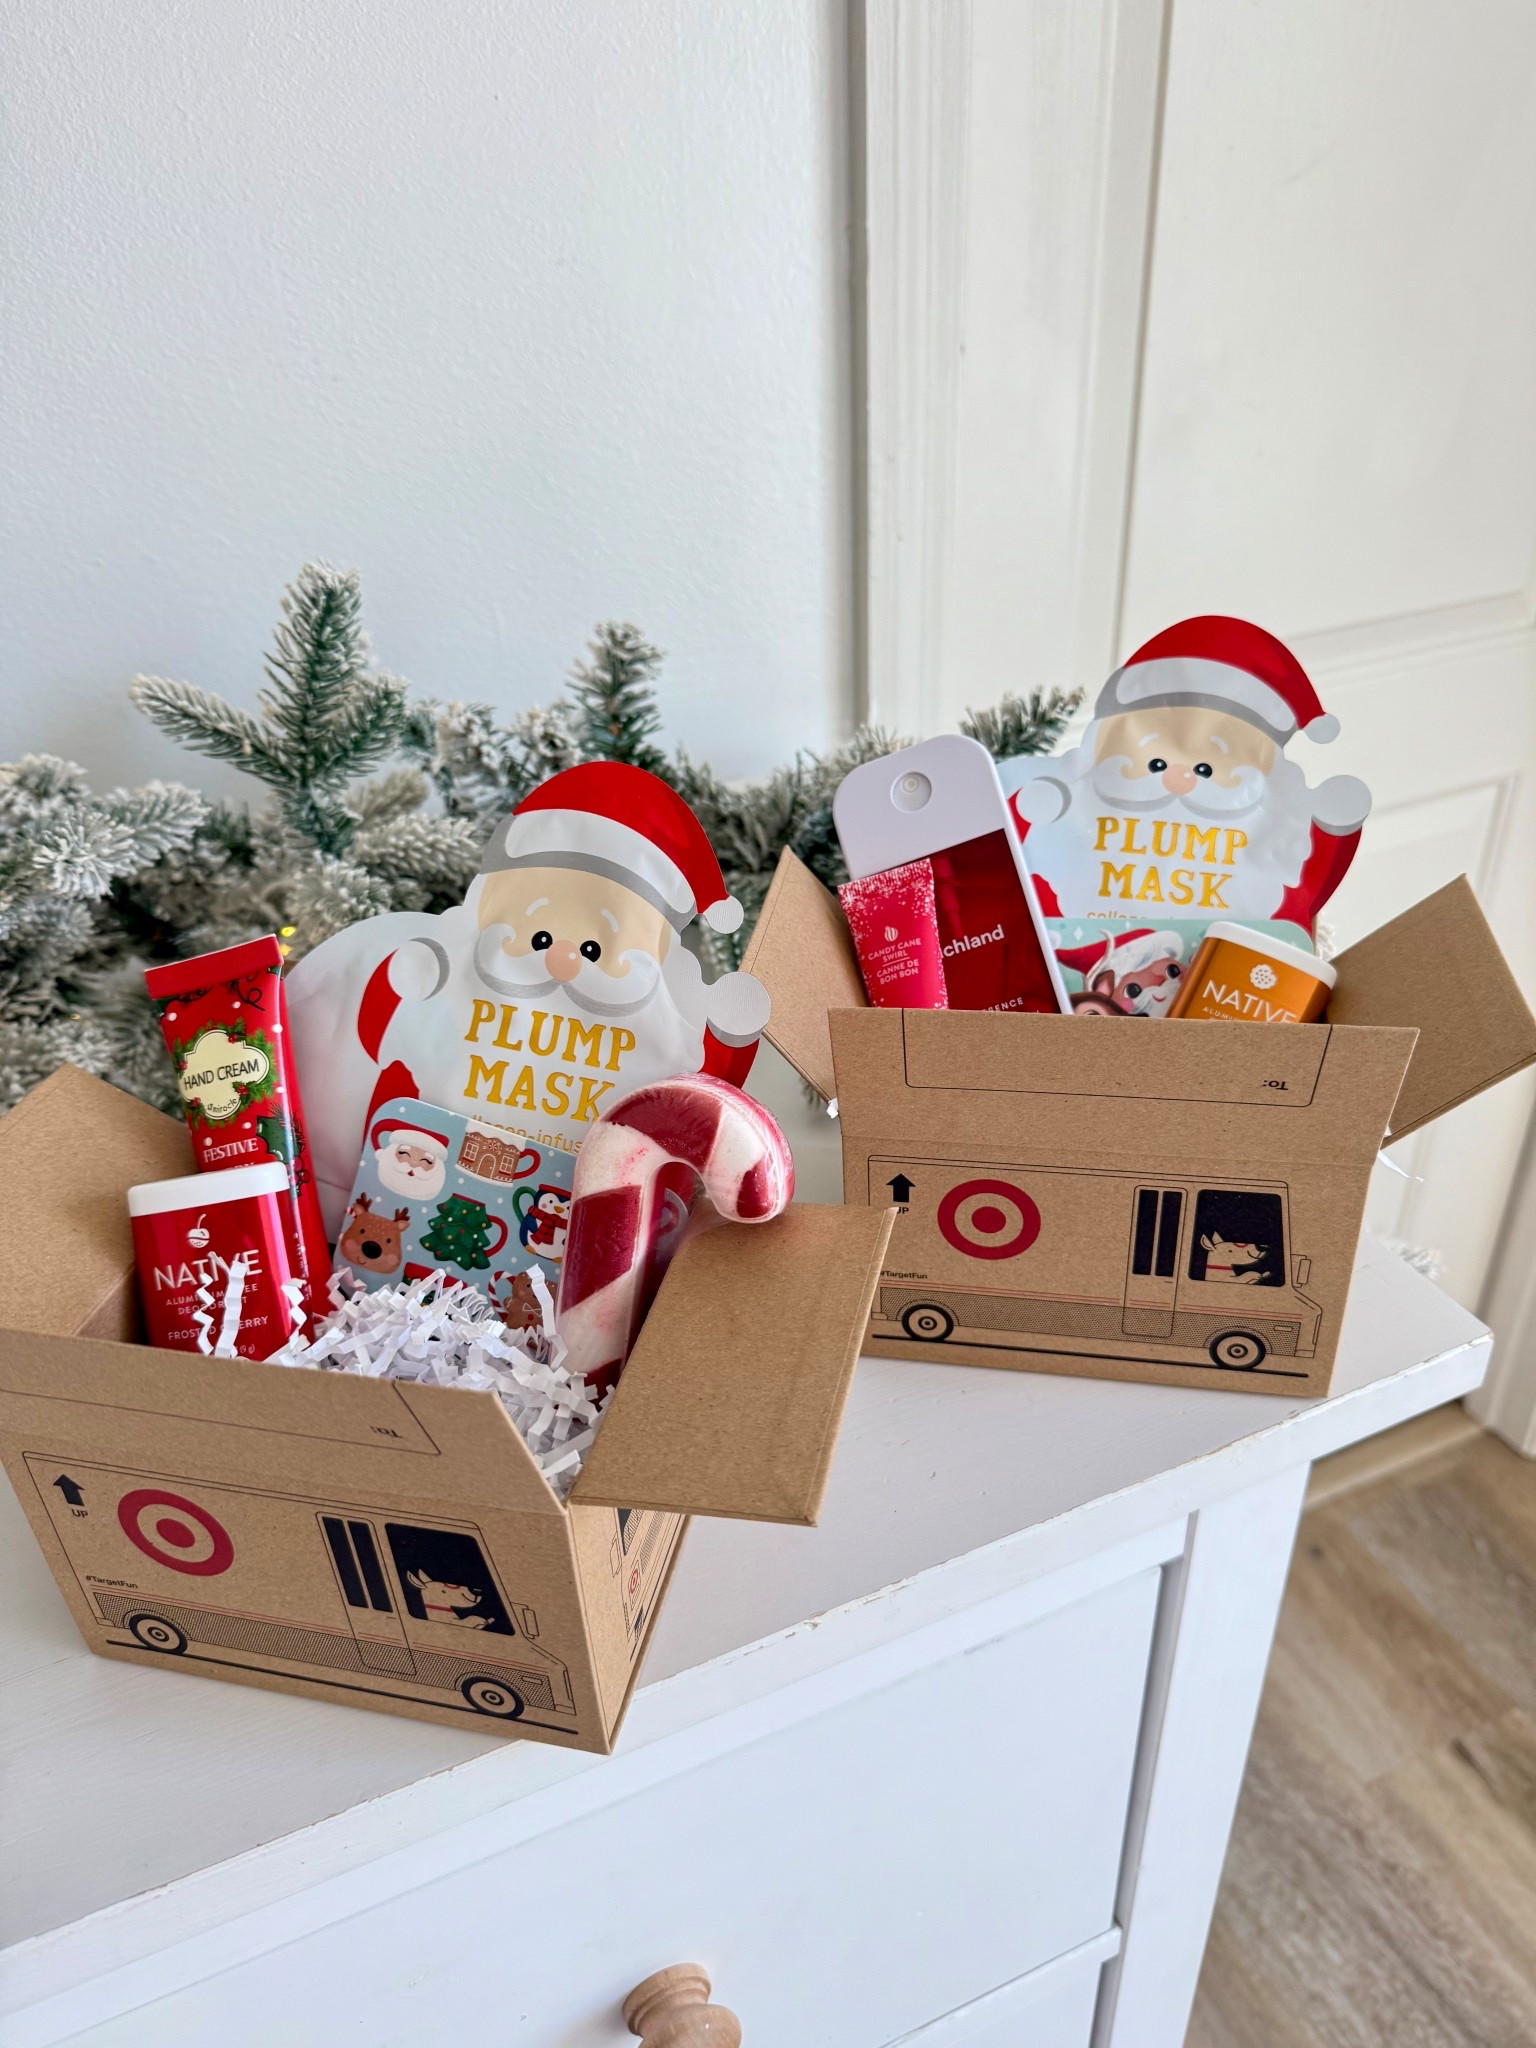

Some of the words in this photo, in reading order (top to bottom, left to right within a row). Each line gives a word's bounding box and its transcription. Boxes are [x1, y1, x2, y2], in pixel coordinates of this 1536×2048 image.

[1093, 816, 1248, 865] PLUMP
[1098, 861, 1233, 910] MASK
[868, 945, 896, 960] CANDY
[897, 938, 921, 950] CANE
[940, 924, 1005, 957] chland
[882, 950, 908, 963] SWIRL
[877, 962, 905, 978] CANNE
[907, 959, 920, 968] DE
[880, 973, 897, 985] BON
[899, 967, 919, 978] BON
[464, 999, 636, 1071] PLUMP
[184, 1070, 214, 1091] HAND
[217, 1059, 260, 1081] CREAM
[1262, 1080, 1289, 1091] To:
[463, 1054, 615, 1124] MASK
[203, 1138, 259, 1163] FESTIVE
[168, 1325, 216, 1341] FROSTD
[71, 1508, 88, 1518] UP
[86, 1575, 138, 1589] #TargetFun
